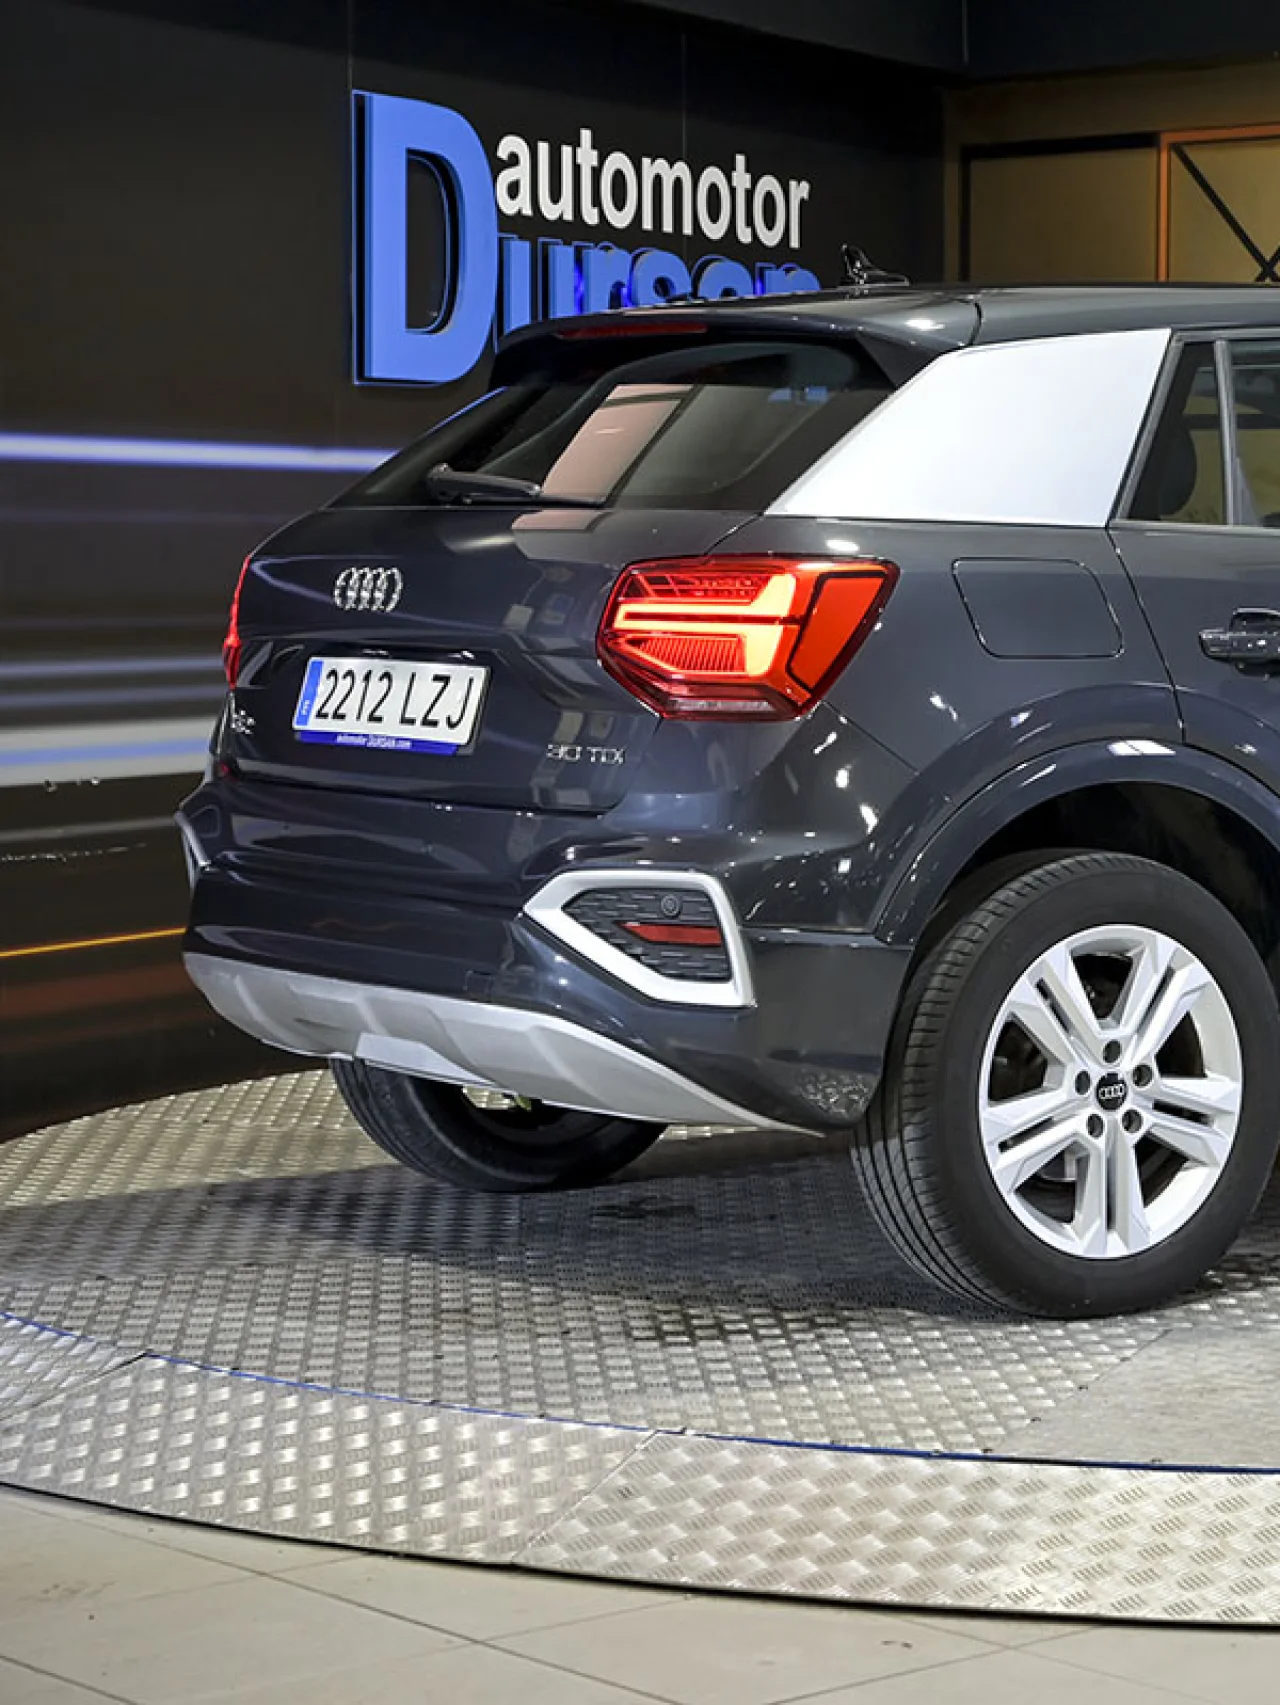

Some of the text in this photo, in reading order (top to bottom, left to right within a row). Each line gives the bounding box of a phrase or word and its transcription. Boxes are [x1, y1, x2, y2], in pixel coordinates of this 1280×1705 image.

[353, 88, 821, 385] Durs
[497, 128, 811, 248] automotor
[315, 667, 475, 729] 2212 LZJ
